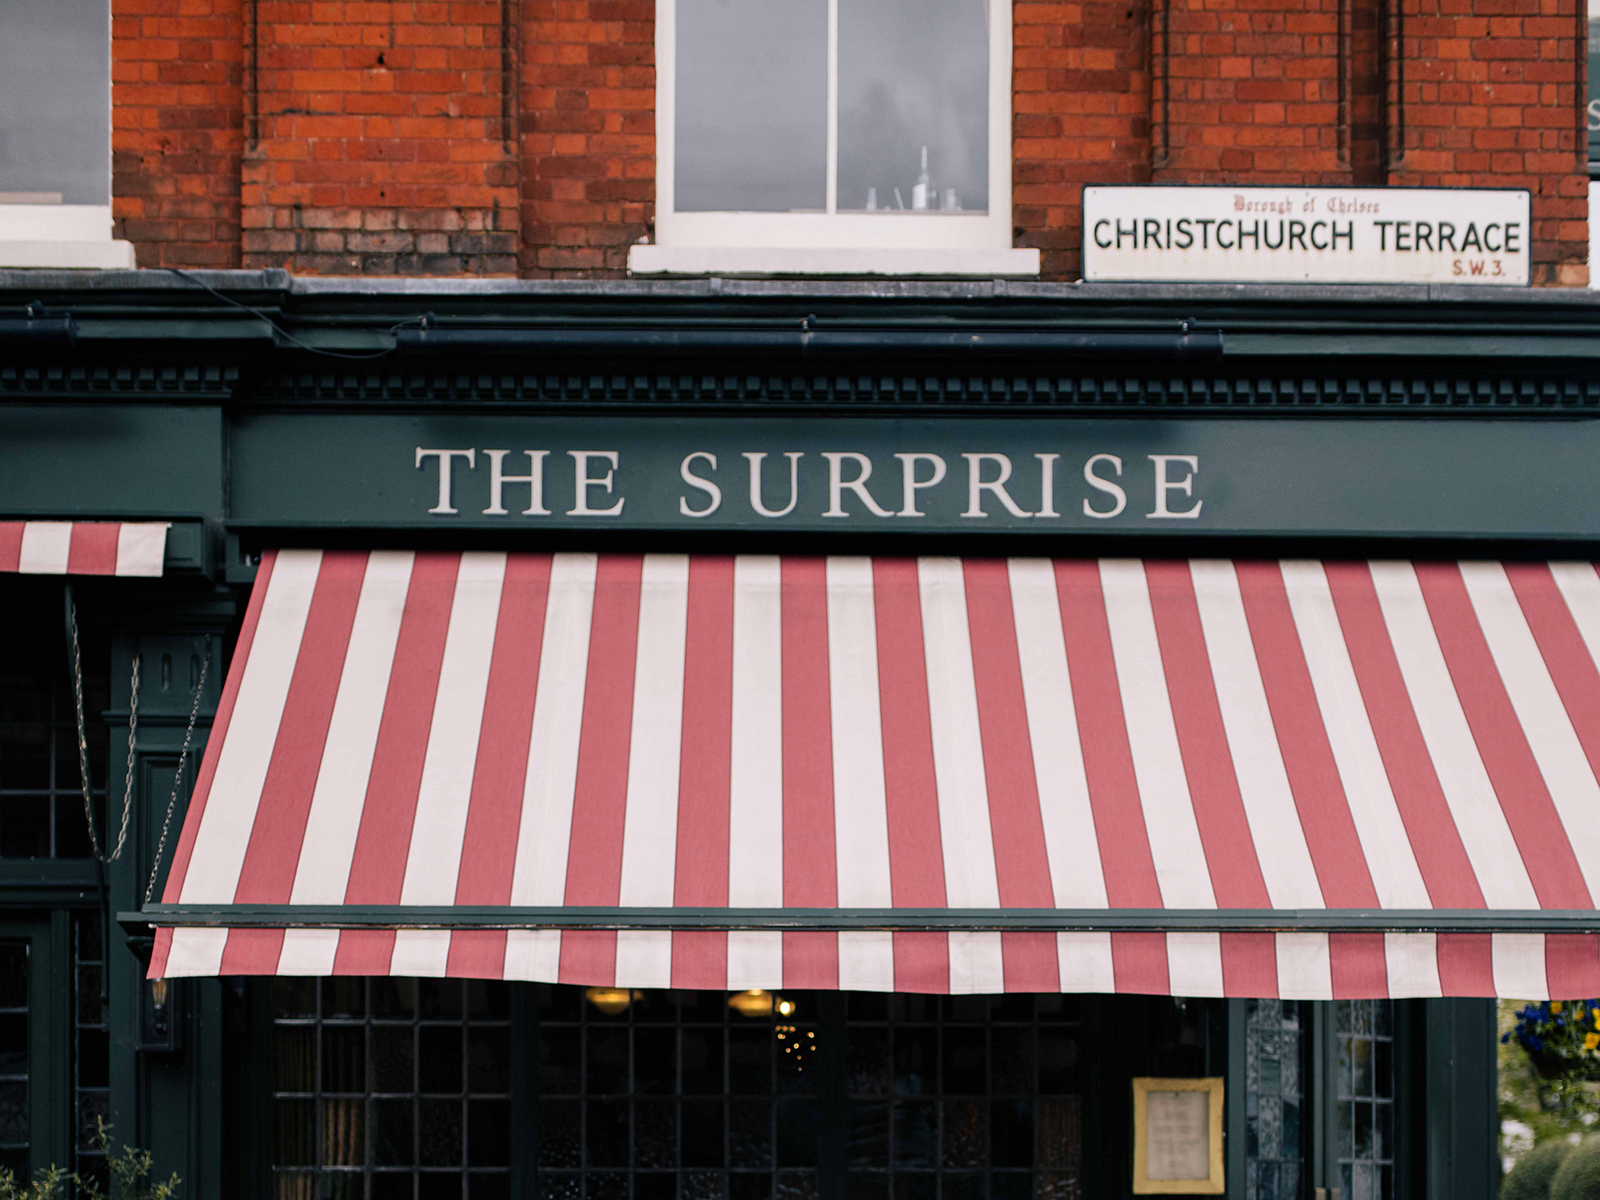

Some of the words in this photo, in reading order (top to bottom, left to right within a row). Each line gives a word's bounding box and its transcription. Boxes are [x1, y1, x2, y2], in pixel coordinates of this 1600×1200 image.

[1234, 194, 1293, 214] Borough
[1303, 195, 1316, 212] of
[1327, 196, 1380, 214] Chelsea
[1093, 218, 1354, 252] CHRISTCHURCH
[1373, 220, 1521, 254] TERRACE
[415, 446, 626, 516] THE
[679, 451, 1205, 519] SURPRISE
